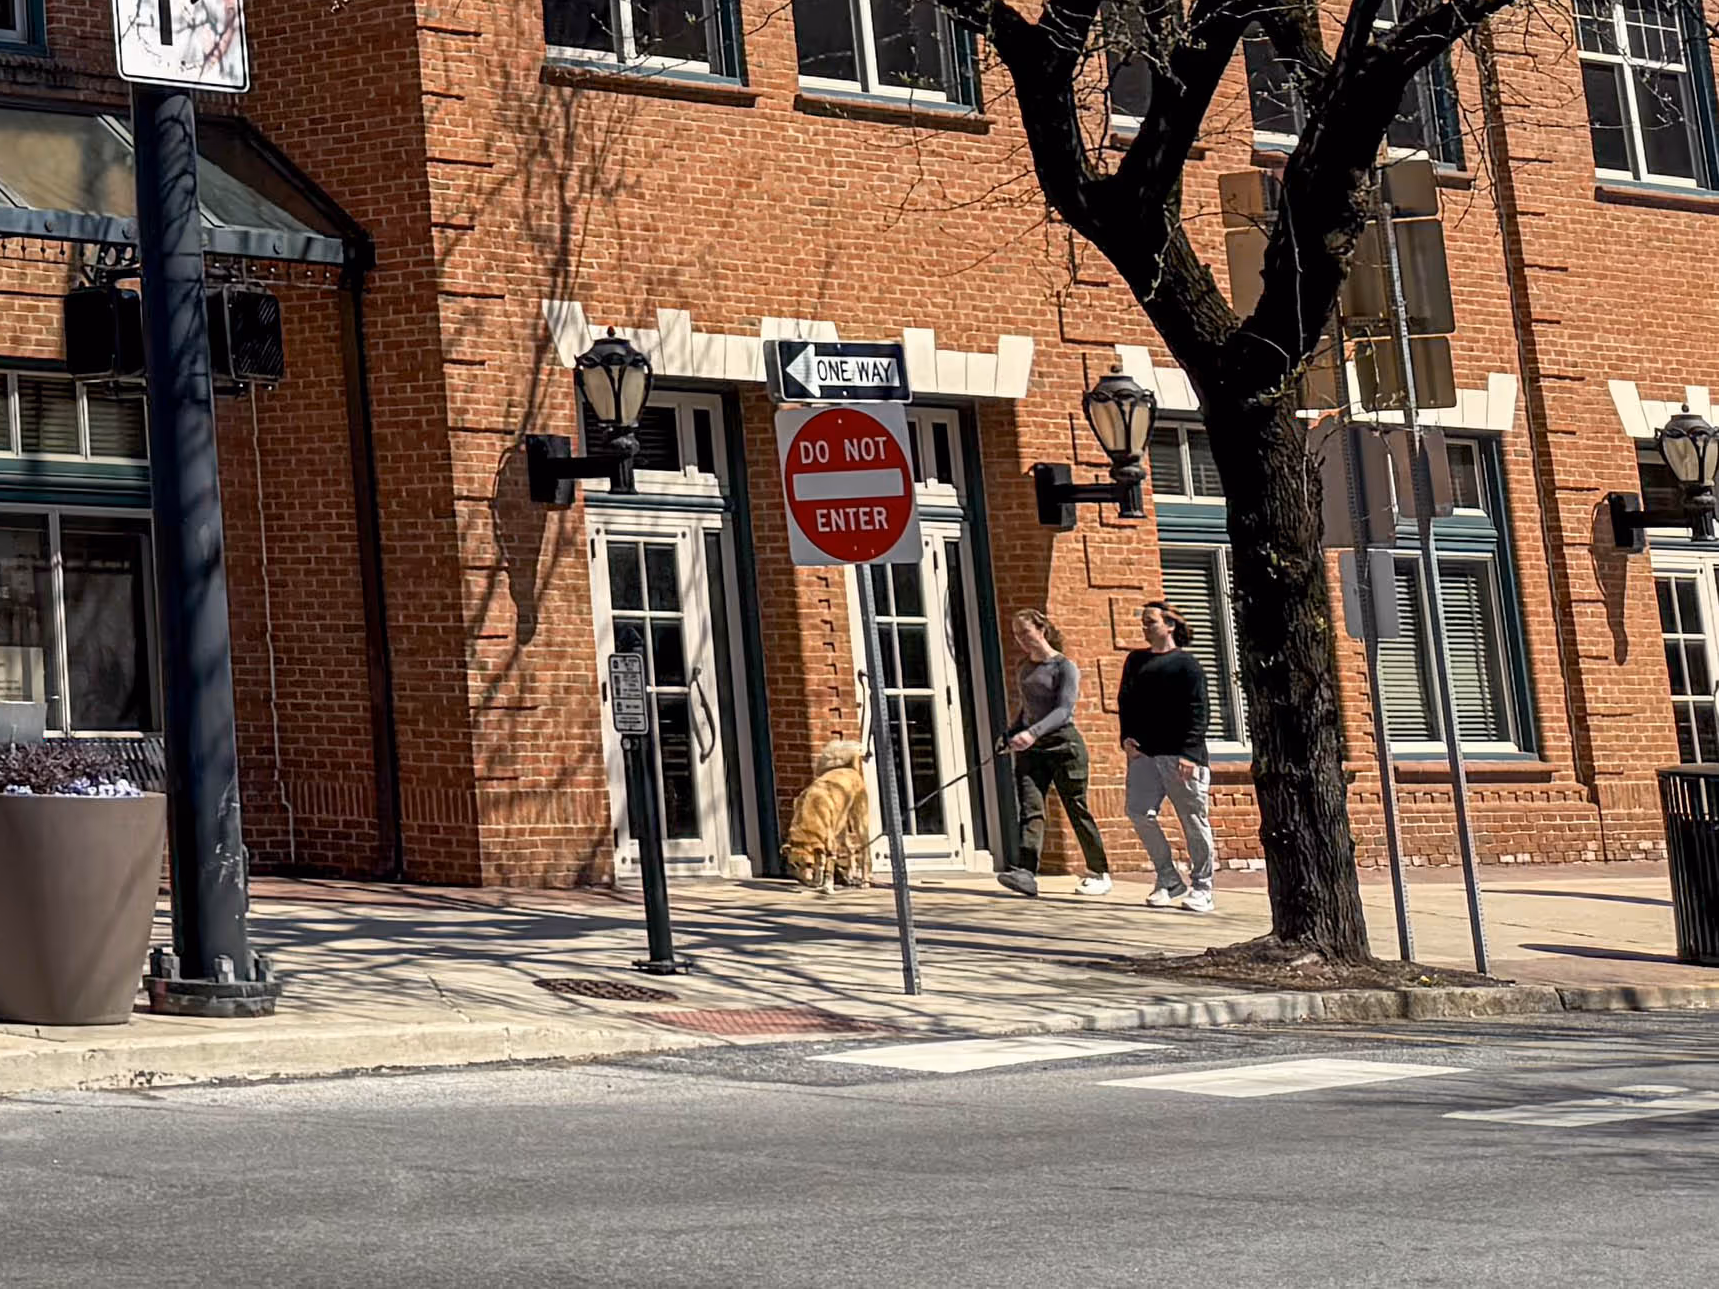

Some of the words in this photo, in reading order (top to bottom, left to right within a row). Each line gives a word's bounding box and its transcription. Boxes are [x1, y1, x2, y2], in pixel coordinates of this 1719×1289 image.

[817, 359, 852, 382] ONE
[856, 360, 892, 383] WAY
[799, 440, 829, 464] DO
[844, 436, 887, 462] NOT
[815, 506, 889, 533] ENTER
